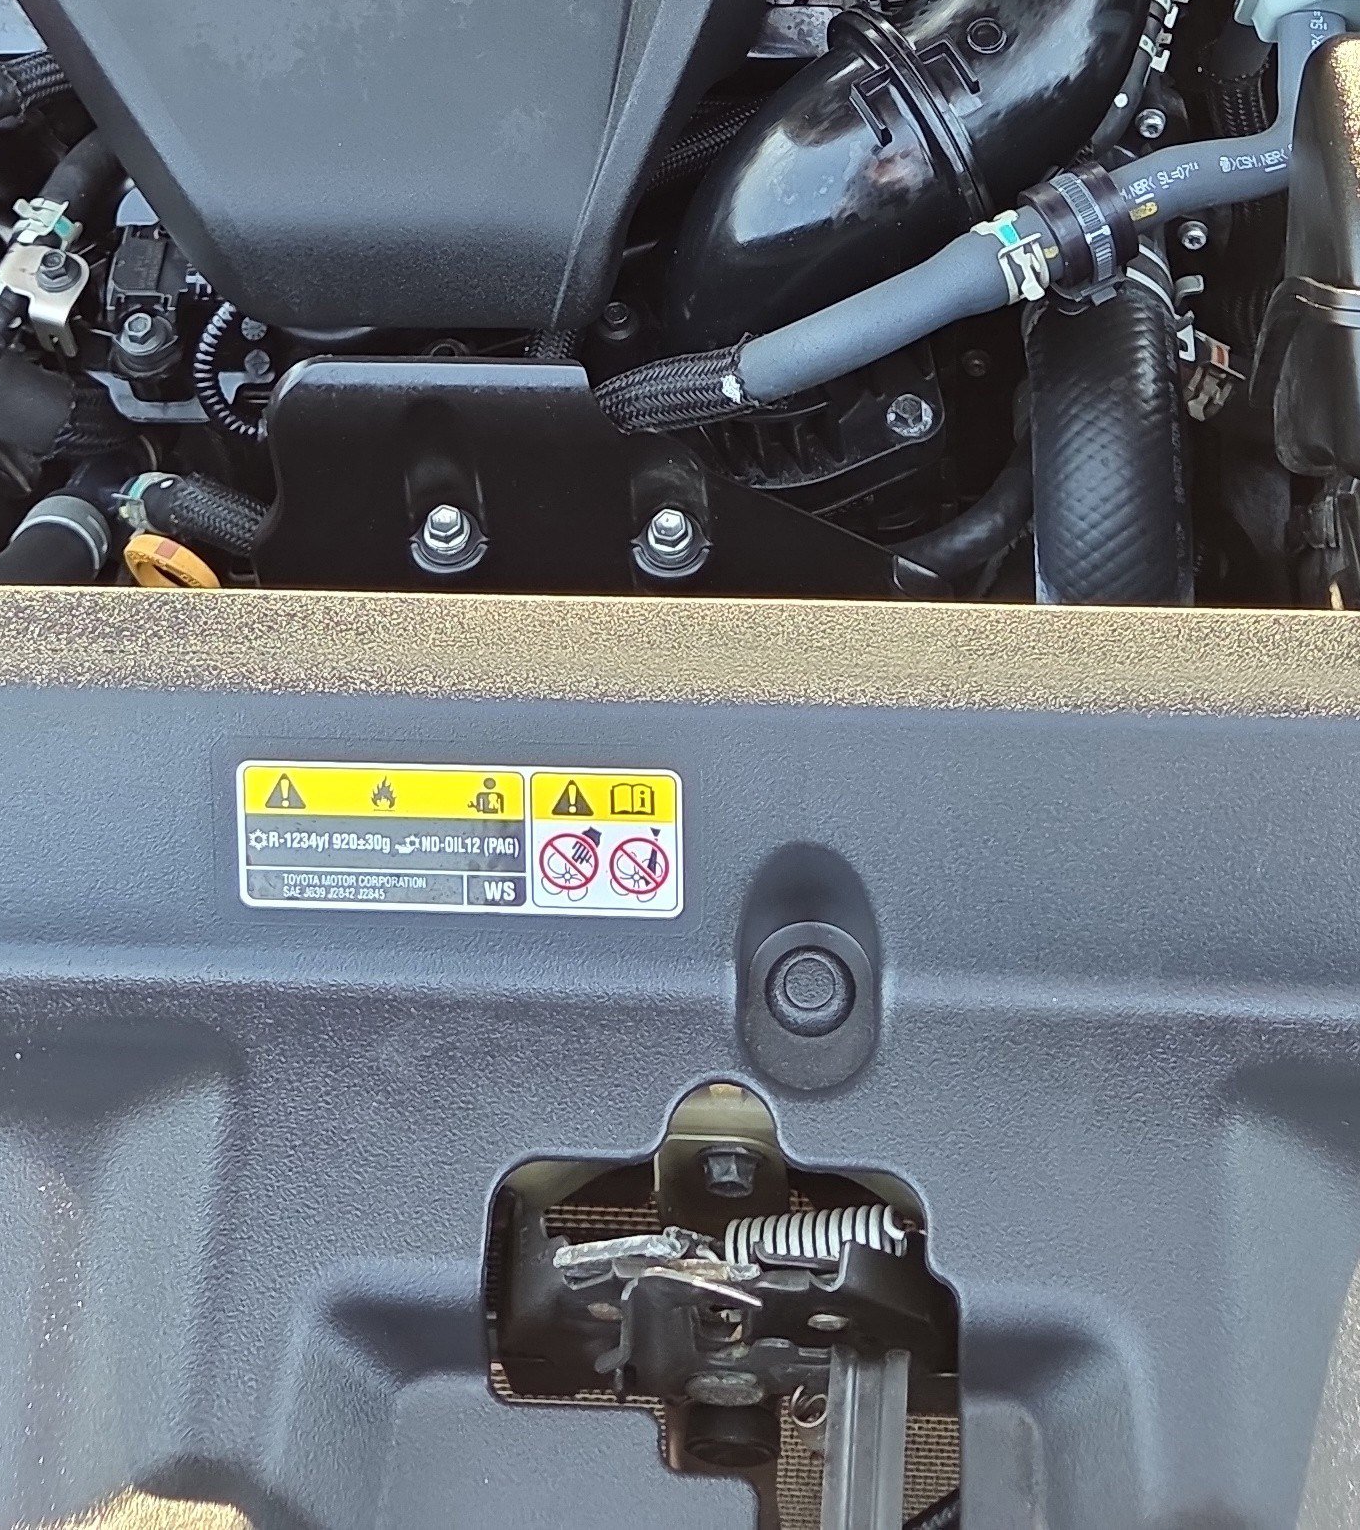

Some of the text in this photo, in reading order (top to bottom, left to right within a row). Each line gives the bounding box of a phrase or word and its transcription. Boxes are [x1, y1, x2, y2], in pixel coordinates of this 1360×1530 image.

[269, 831, 519, 857] R-1234yf 920±30g ND-OIL12 (PAG)
[283, 874, 426, 888] TOYOTA MOTOR CORPORATION
[483, 881, 516, 901] WS
